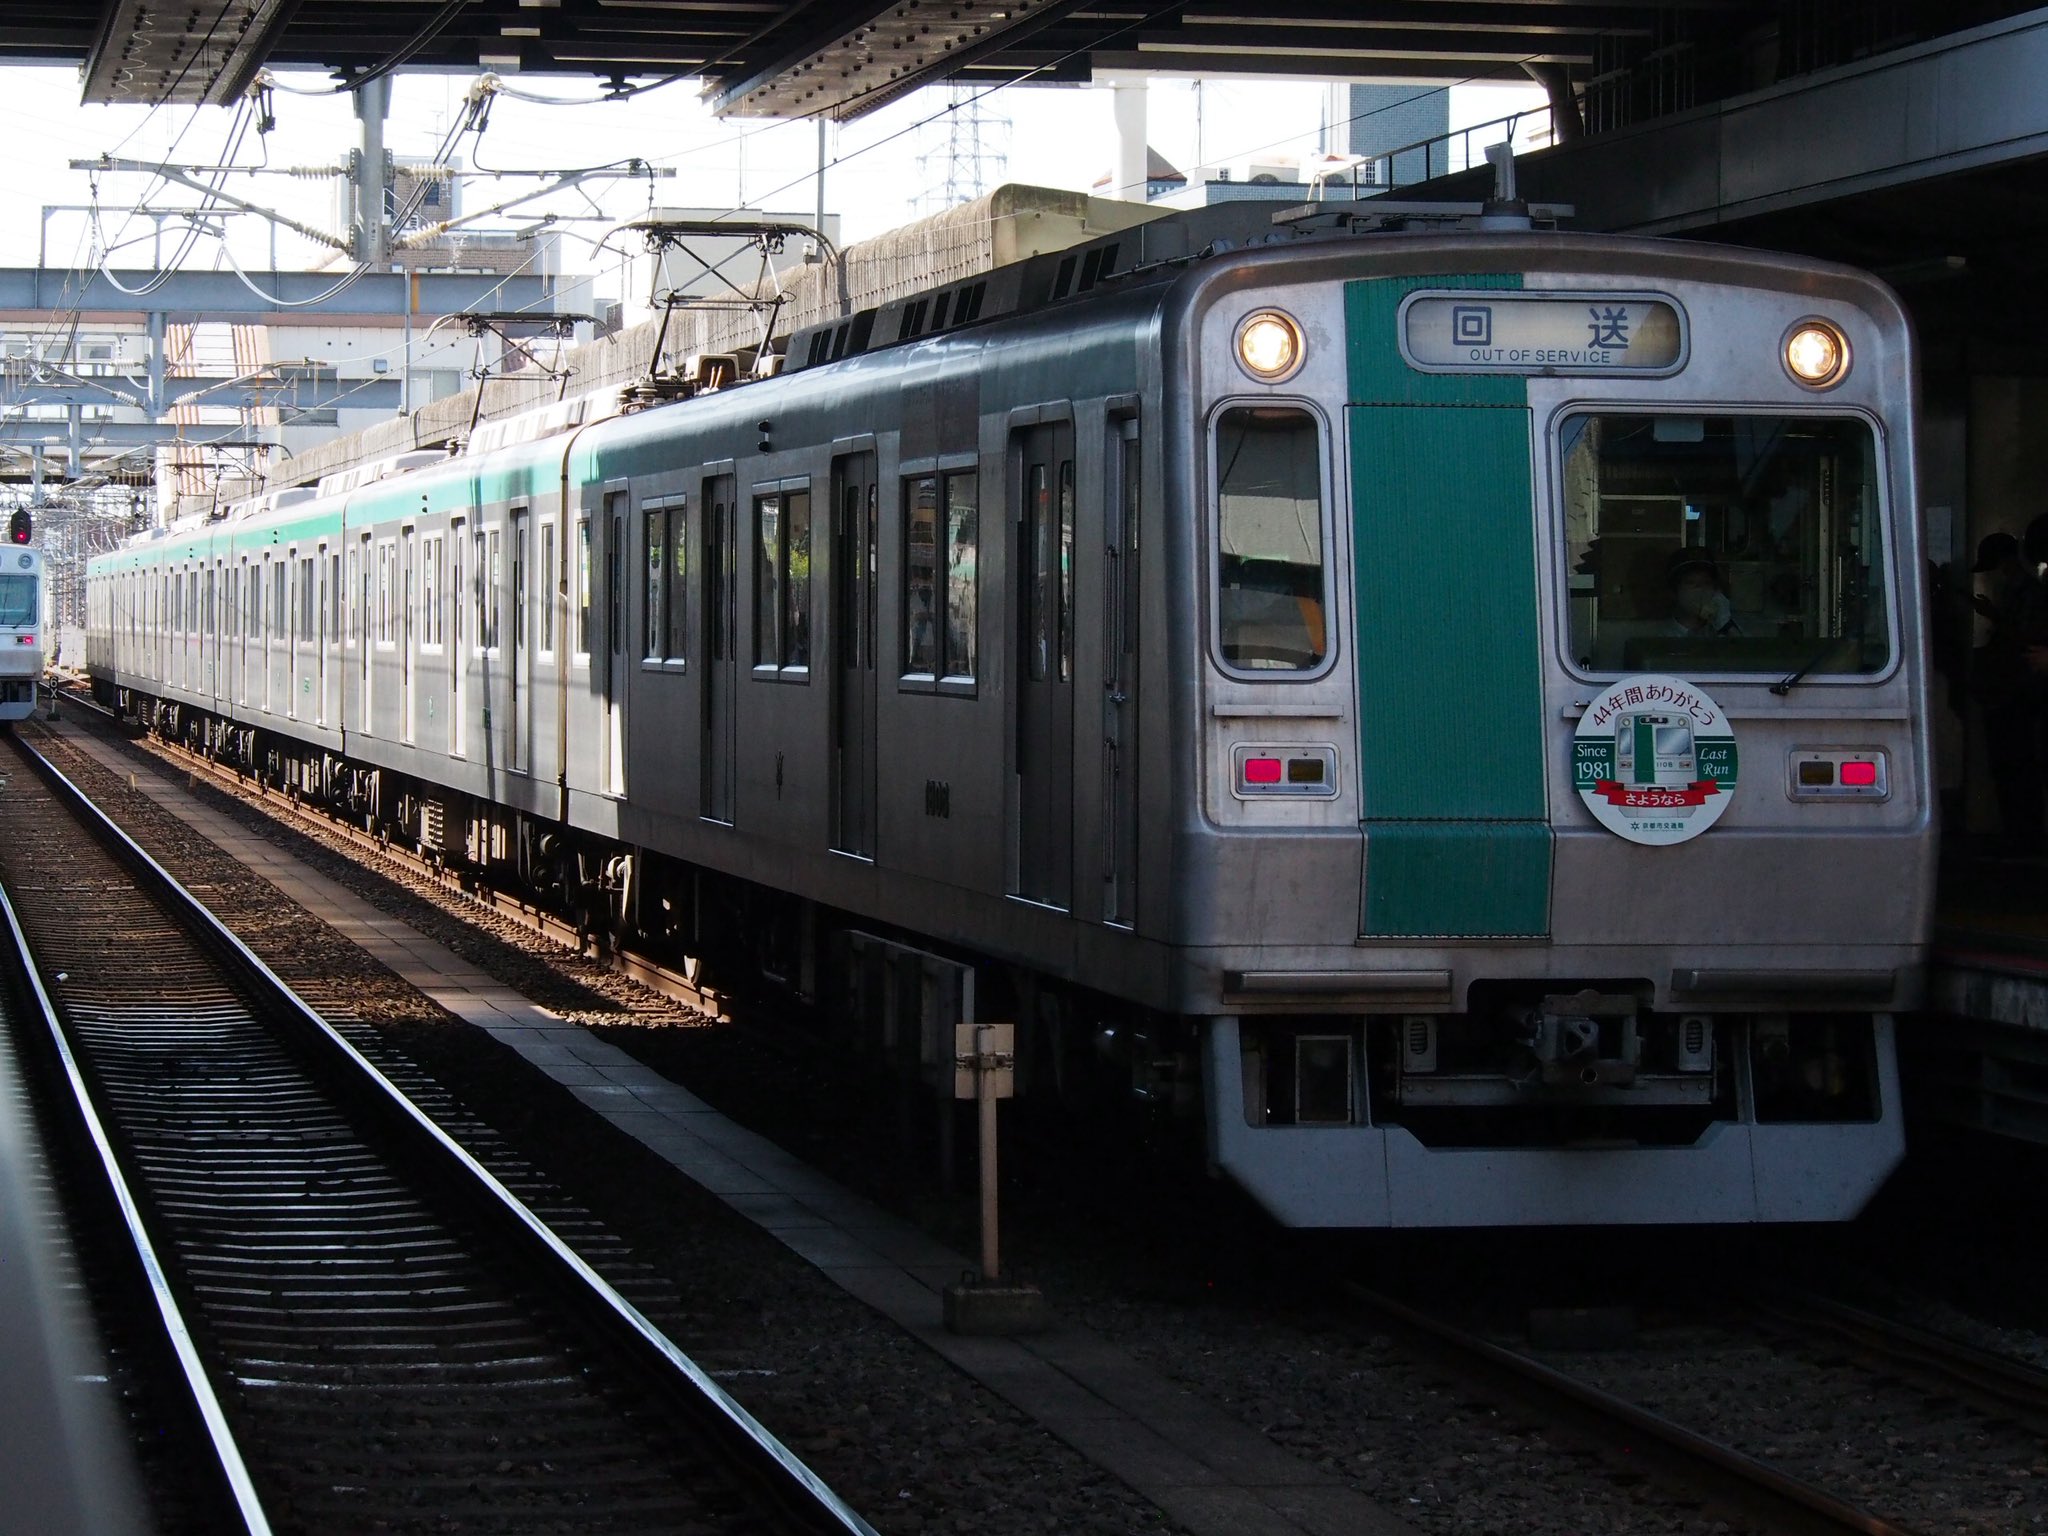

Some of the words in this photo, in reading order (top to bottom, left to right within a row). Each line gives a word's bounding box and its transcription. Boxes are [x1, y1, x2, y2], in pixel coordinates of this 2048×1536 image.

[1453, 306, 1491, 346] 回
[1588, 306, 1629, 349] 送
[1470, 349, 1504, 361] OUT
[1509, 349, 1531, 361] OF
[1535, 350, 1610, 363] SERVICE
[1577, 744, 1607, 757] Since
[1700, 748, 1728, 760] Last
[1576, 762, 1611, 779] 1981
[1703, 763, 1729, 776] Run
[1625, 793, 1686, 806] さようなら
